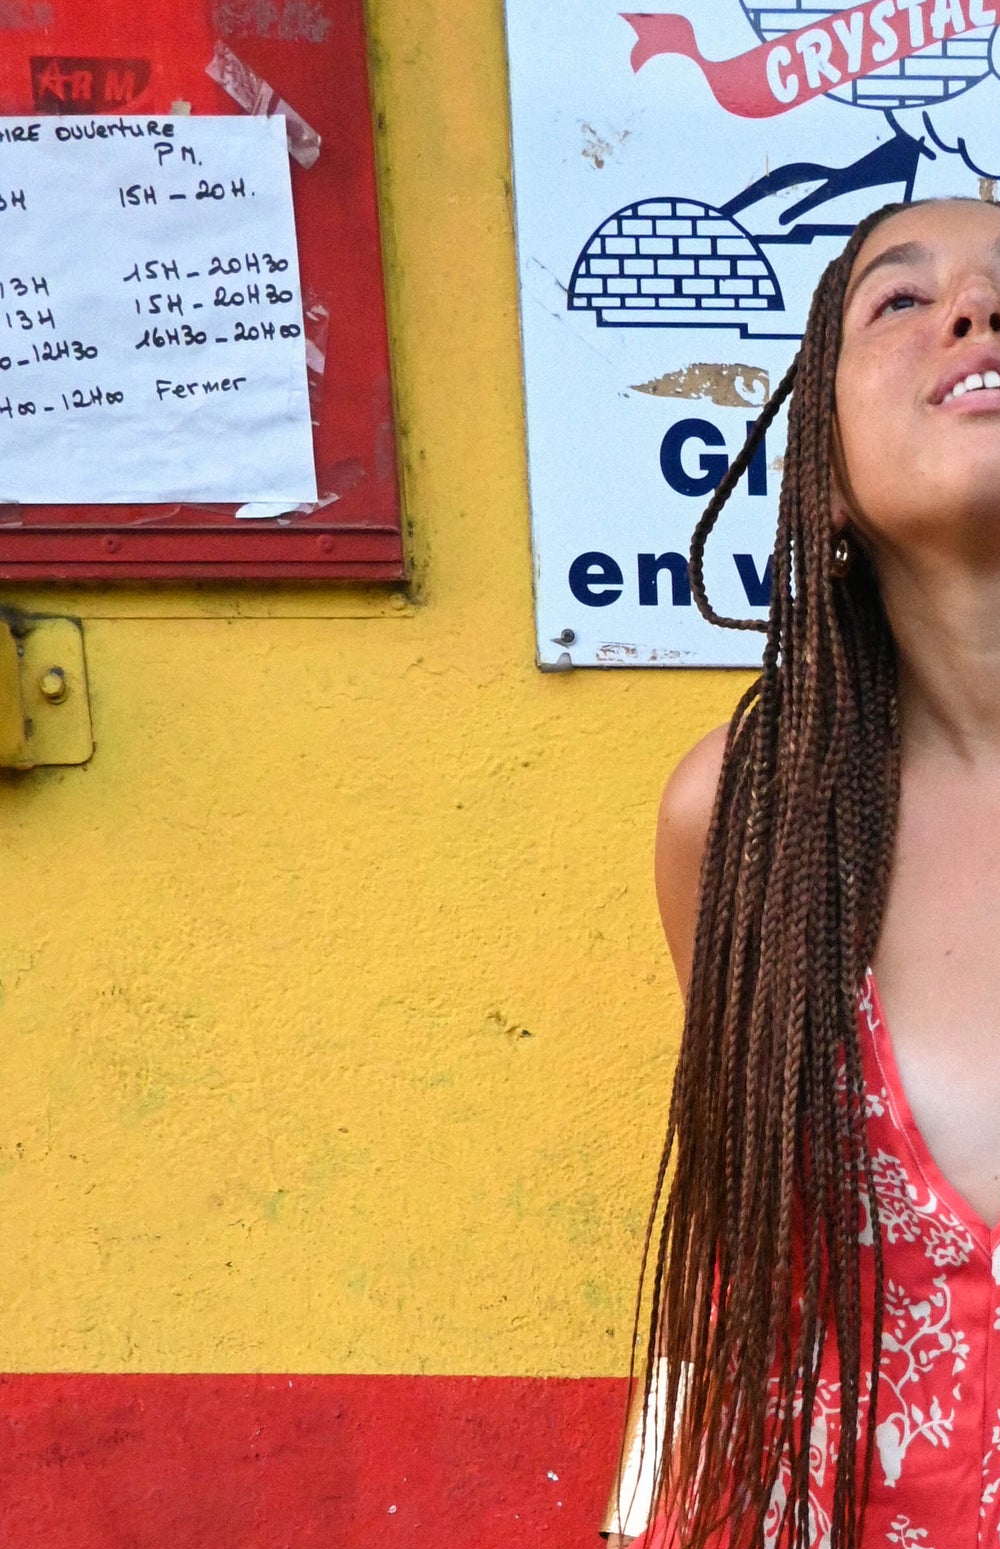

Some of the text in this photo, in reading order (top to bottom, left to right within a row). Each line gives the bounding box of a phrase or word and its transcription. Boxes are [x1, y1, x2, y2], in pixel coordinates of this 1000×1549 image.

[766, 0, 996, 103] CRYSTAL
[0, 123, 41, 142] IRE
[119, 184, 157, 208] 15H
[123, 259, 180, 282] 15H
[208, 252, 289, 276] 20H30
[135, 293, 184, 317] 15H
[214, 283, 293, 307] 20H30
[135, 324, 207, 350] 16H30
[156, 377, 247, 401] Fermer
[568, 551, 691, 607] en
